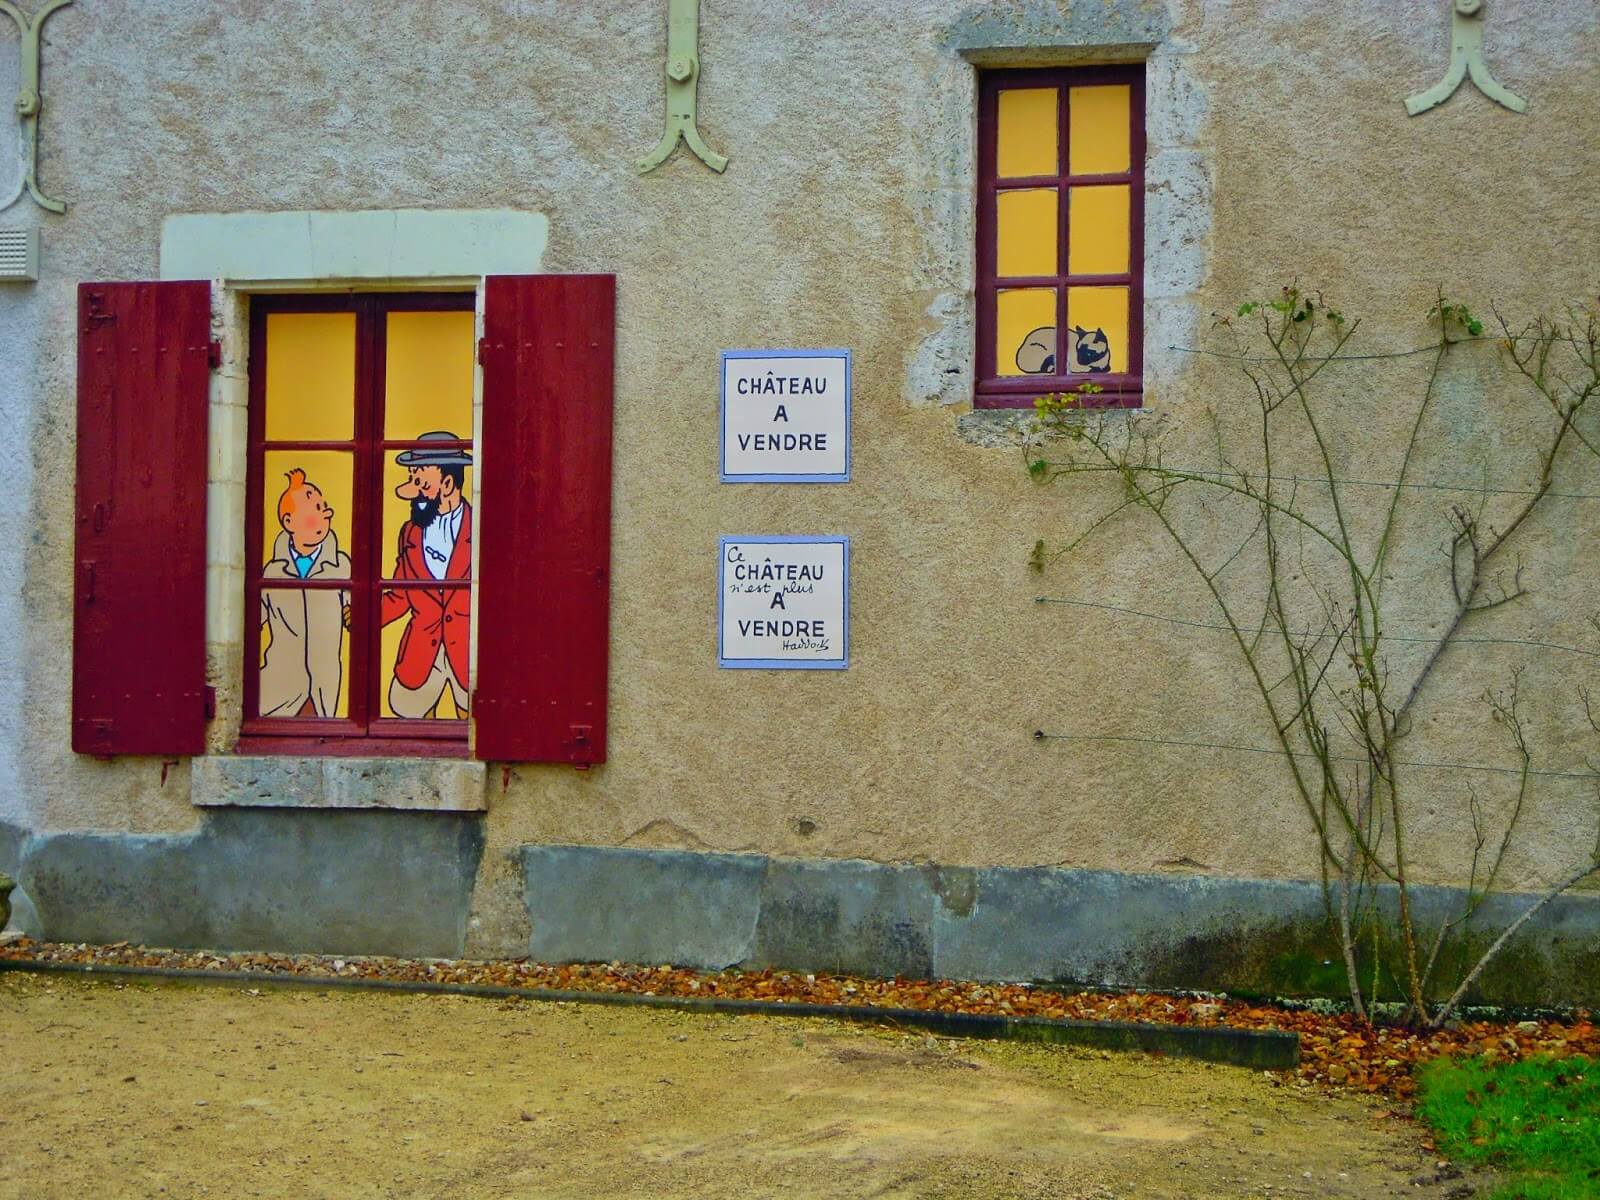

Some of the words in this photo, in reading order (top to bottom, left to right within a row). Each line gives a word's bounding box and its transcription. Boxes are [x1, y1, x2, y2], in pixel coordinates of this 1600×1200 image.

[737, 370, 827, 395] CHÂTEAU
[773, 404, 788, 422] A
[737, 433, 827, 451] VENDRE
[727, 546, 746, 563] Ce
[735, 557, 824, 581] CHÂTEAU
[730, 582, 771, 593] n'est
[781, 580, 814, 597] plus
[770, 591, 786, 610] A
[738, 619, 825, 637] VENDRE
[782, 638, 830, 652] Haddock
